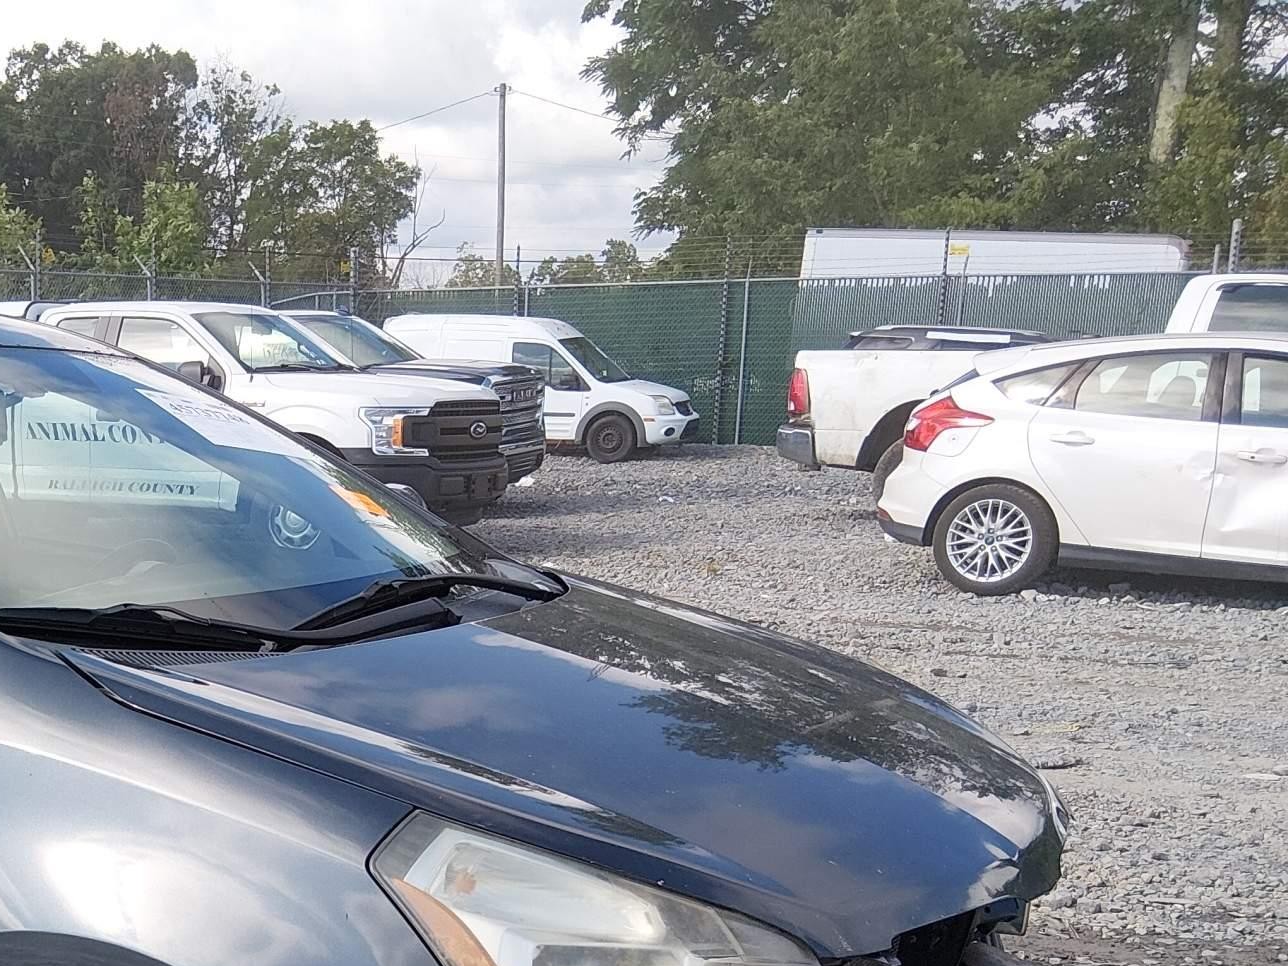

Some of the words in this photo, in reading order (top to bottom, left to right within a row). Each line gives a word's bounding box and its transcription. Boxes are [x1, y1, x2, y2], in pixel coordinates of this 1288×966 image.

[26, 421, 105, 442] ANIMAL
[108, 423, 165, 445] CON
[127, 480, 200, 497] COUNTY
